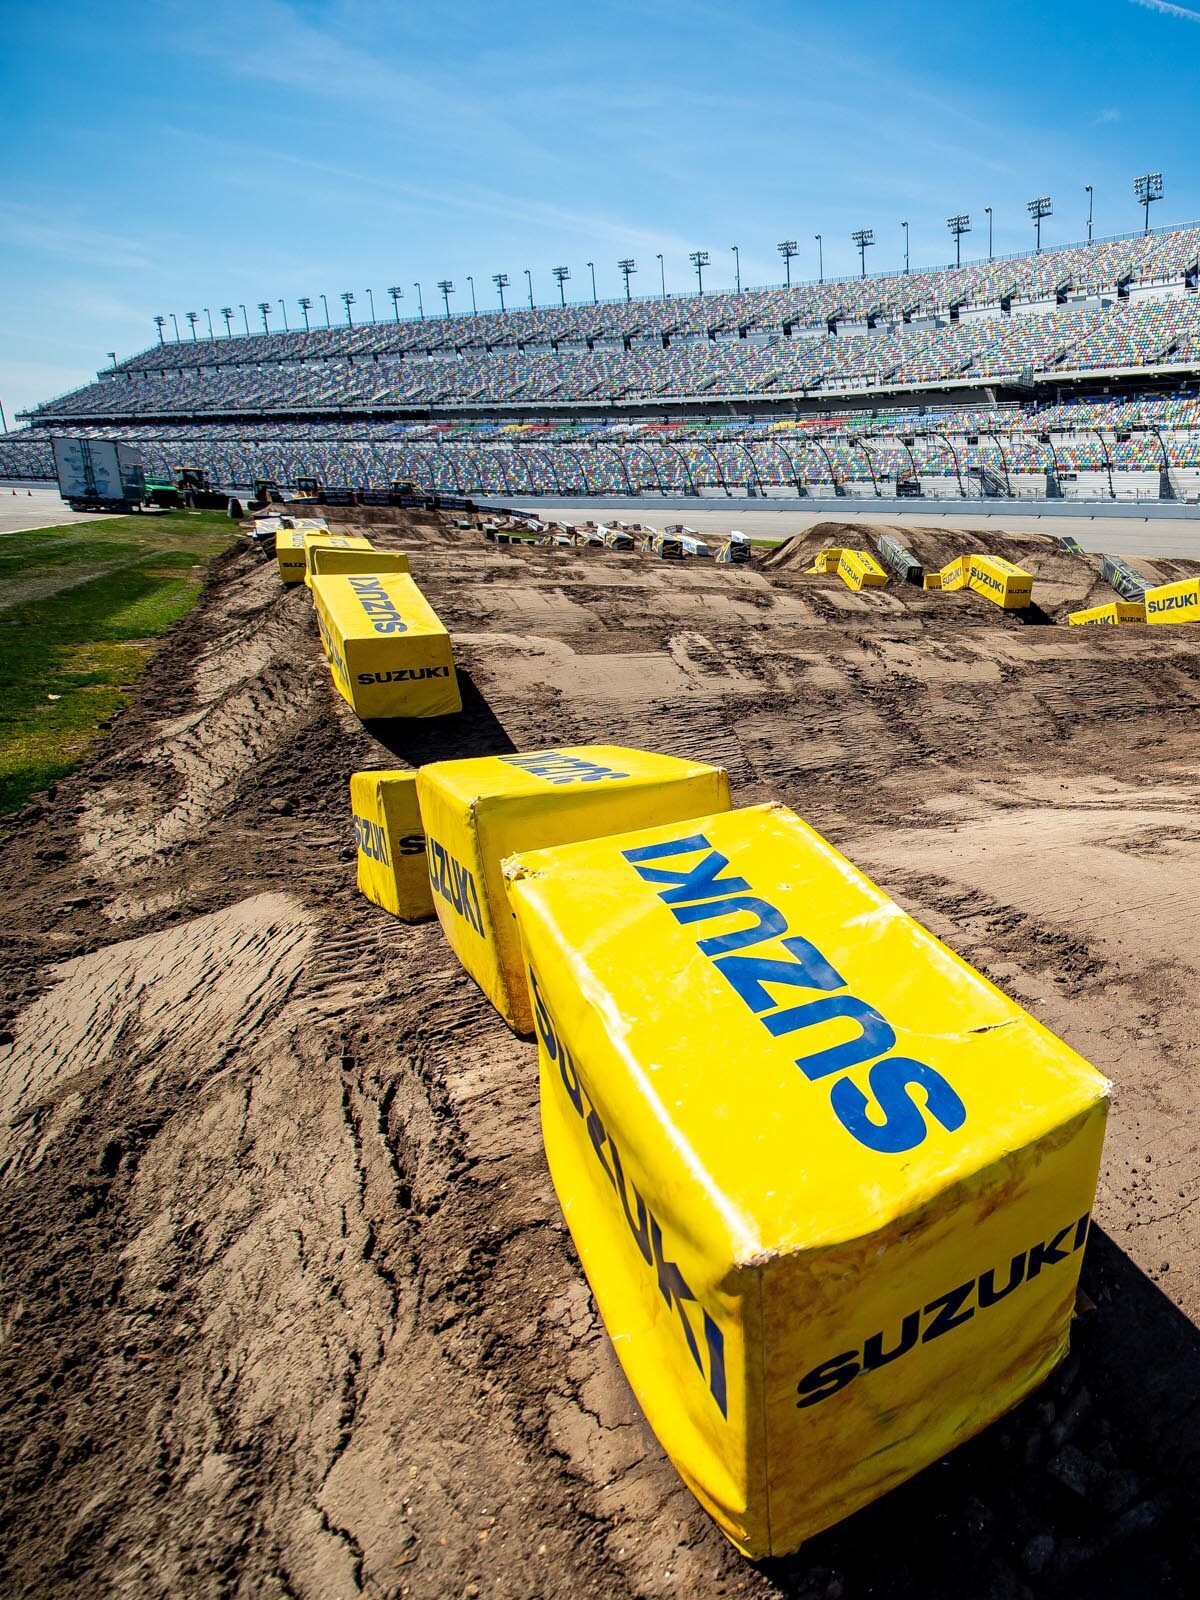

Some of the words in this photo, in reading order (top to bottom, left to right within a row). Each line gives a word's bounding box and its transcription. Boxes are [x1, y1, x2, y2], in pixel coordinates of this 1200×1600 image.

[942, 567, 963, 587] SUZUKI
[970, 566, 1005, 594] SUZUKI
[1148, 592, 1199, 614] SUZUKI
[348, 577, 408, 633] SUZUKI
[357, 666, 450, 685] SUZUKI
[497, 751, 631, 785] SUZUKI
[353, 814, 390, 868] SZUKI
[425, 833, 486, 940] UZUKI
[620, 833, 967, 1154] SUZUKI
[528, 962, 728, 1422] SUZUKI
[796, 1211, 1091, 1410] SUZUKI
